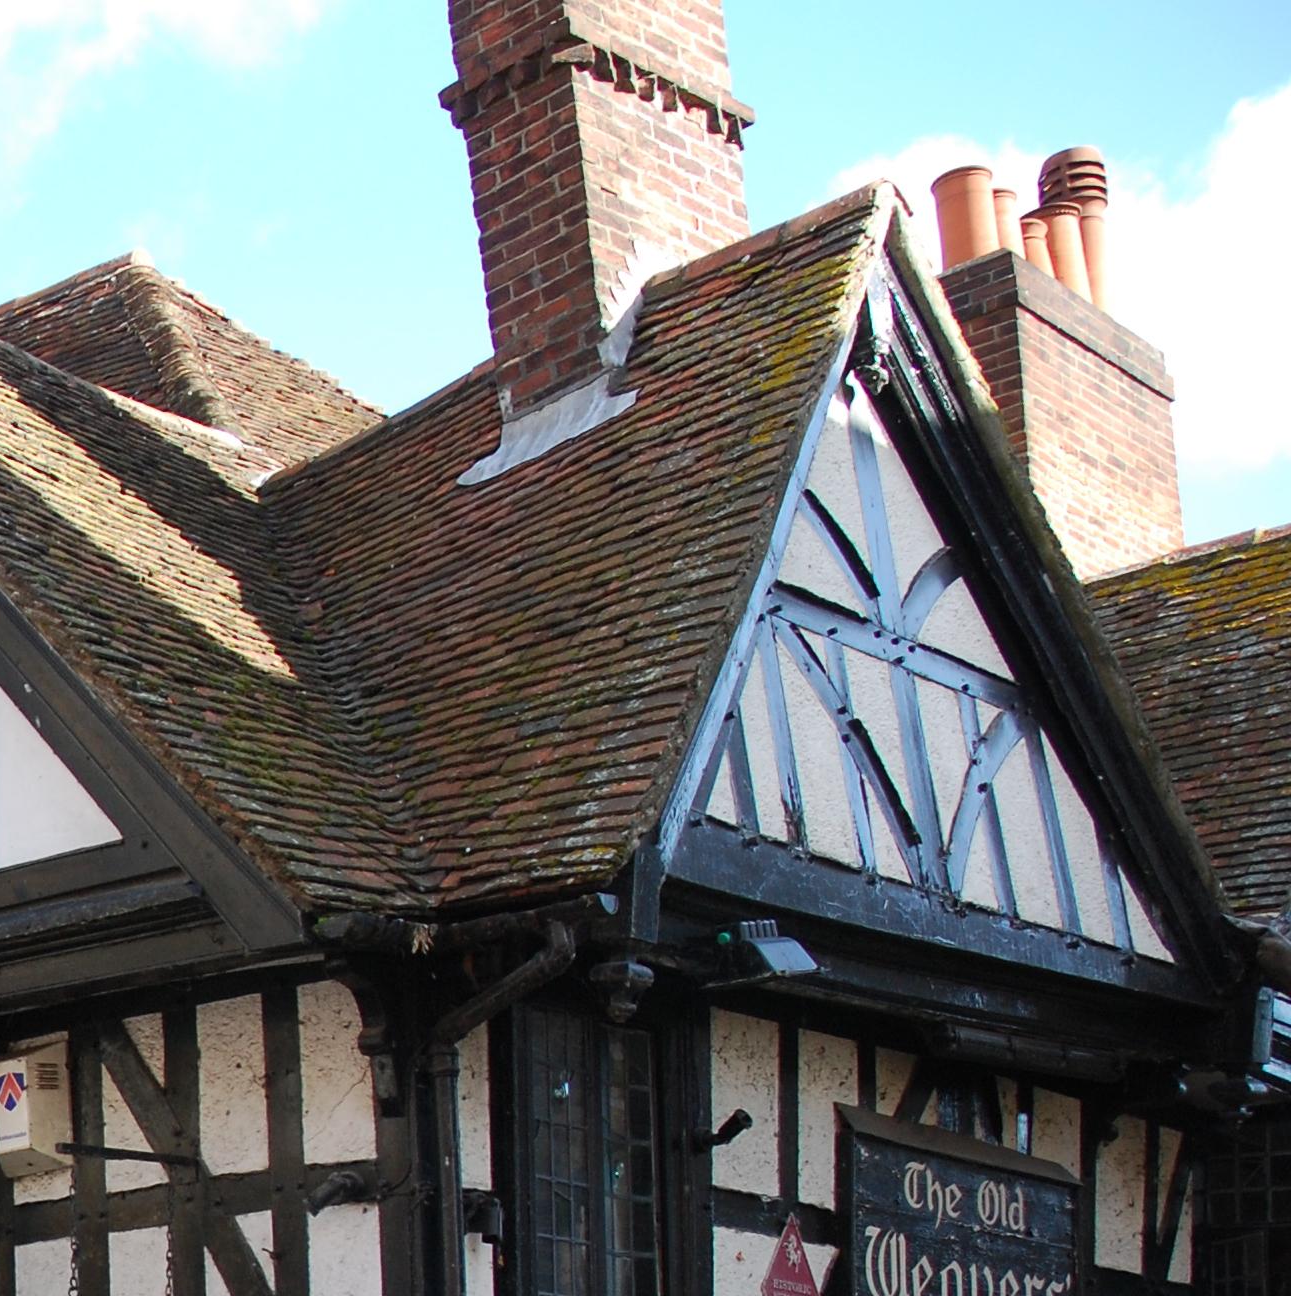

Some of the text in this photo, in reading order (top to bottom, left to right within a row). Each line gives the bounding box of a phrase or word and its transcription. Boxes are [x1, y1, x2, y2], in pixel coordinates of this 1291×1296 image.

[904, 1161, 1026, 1232] The Old
[772, 1278, 812, 1295] HISTORIC
